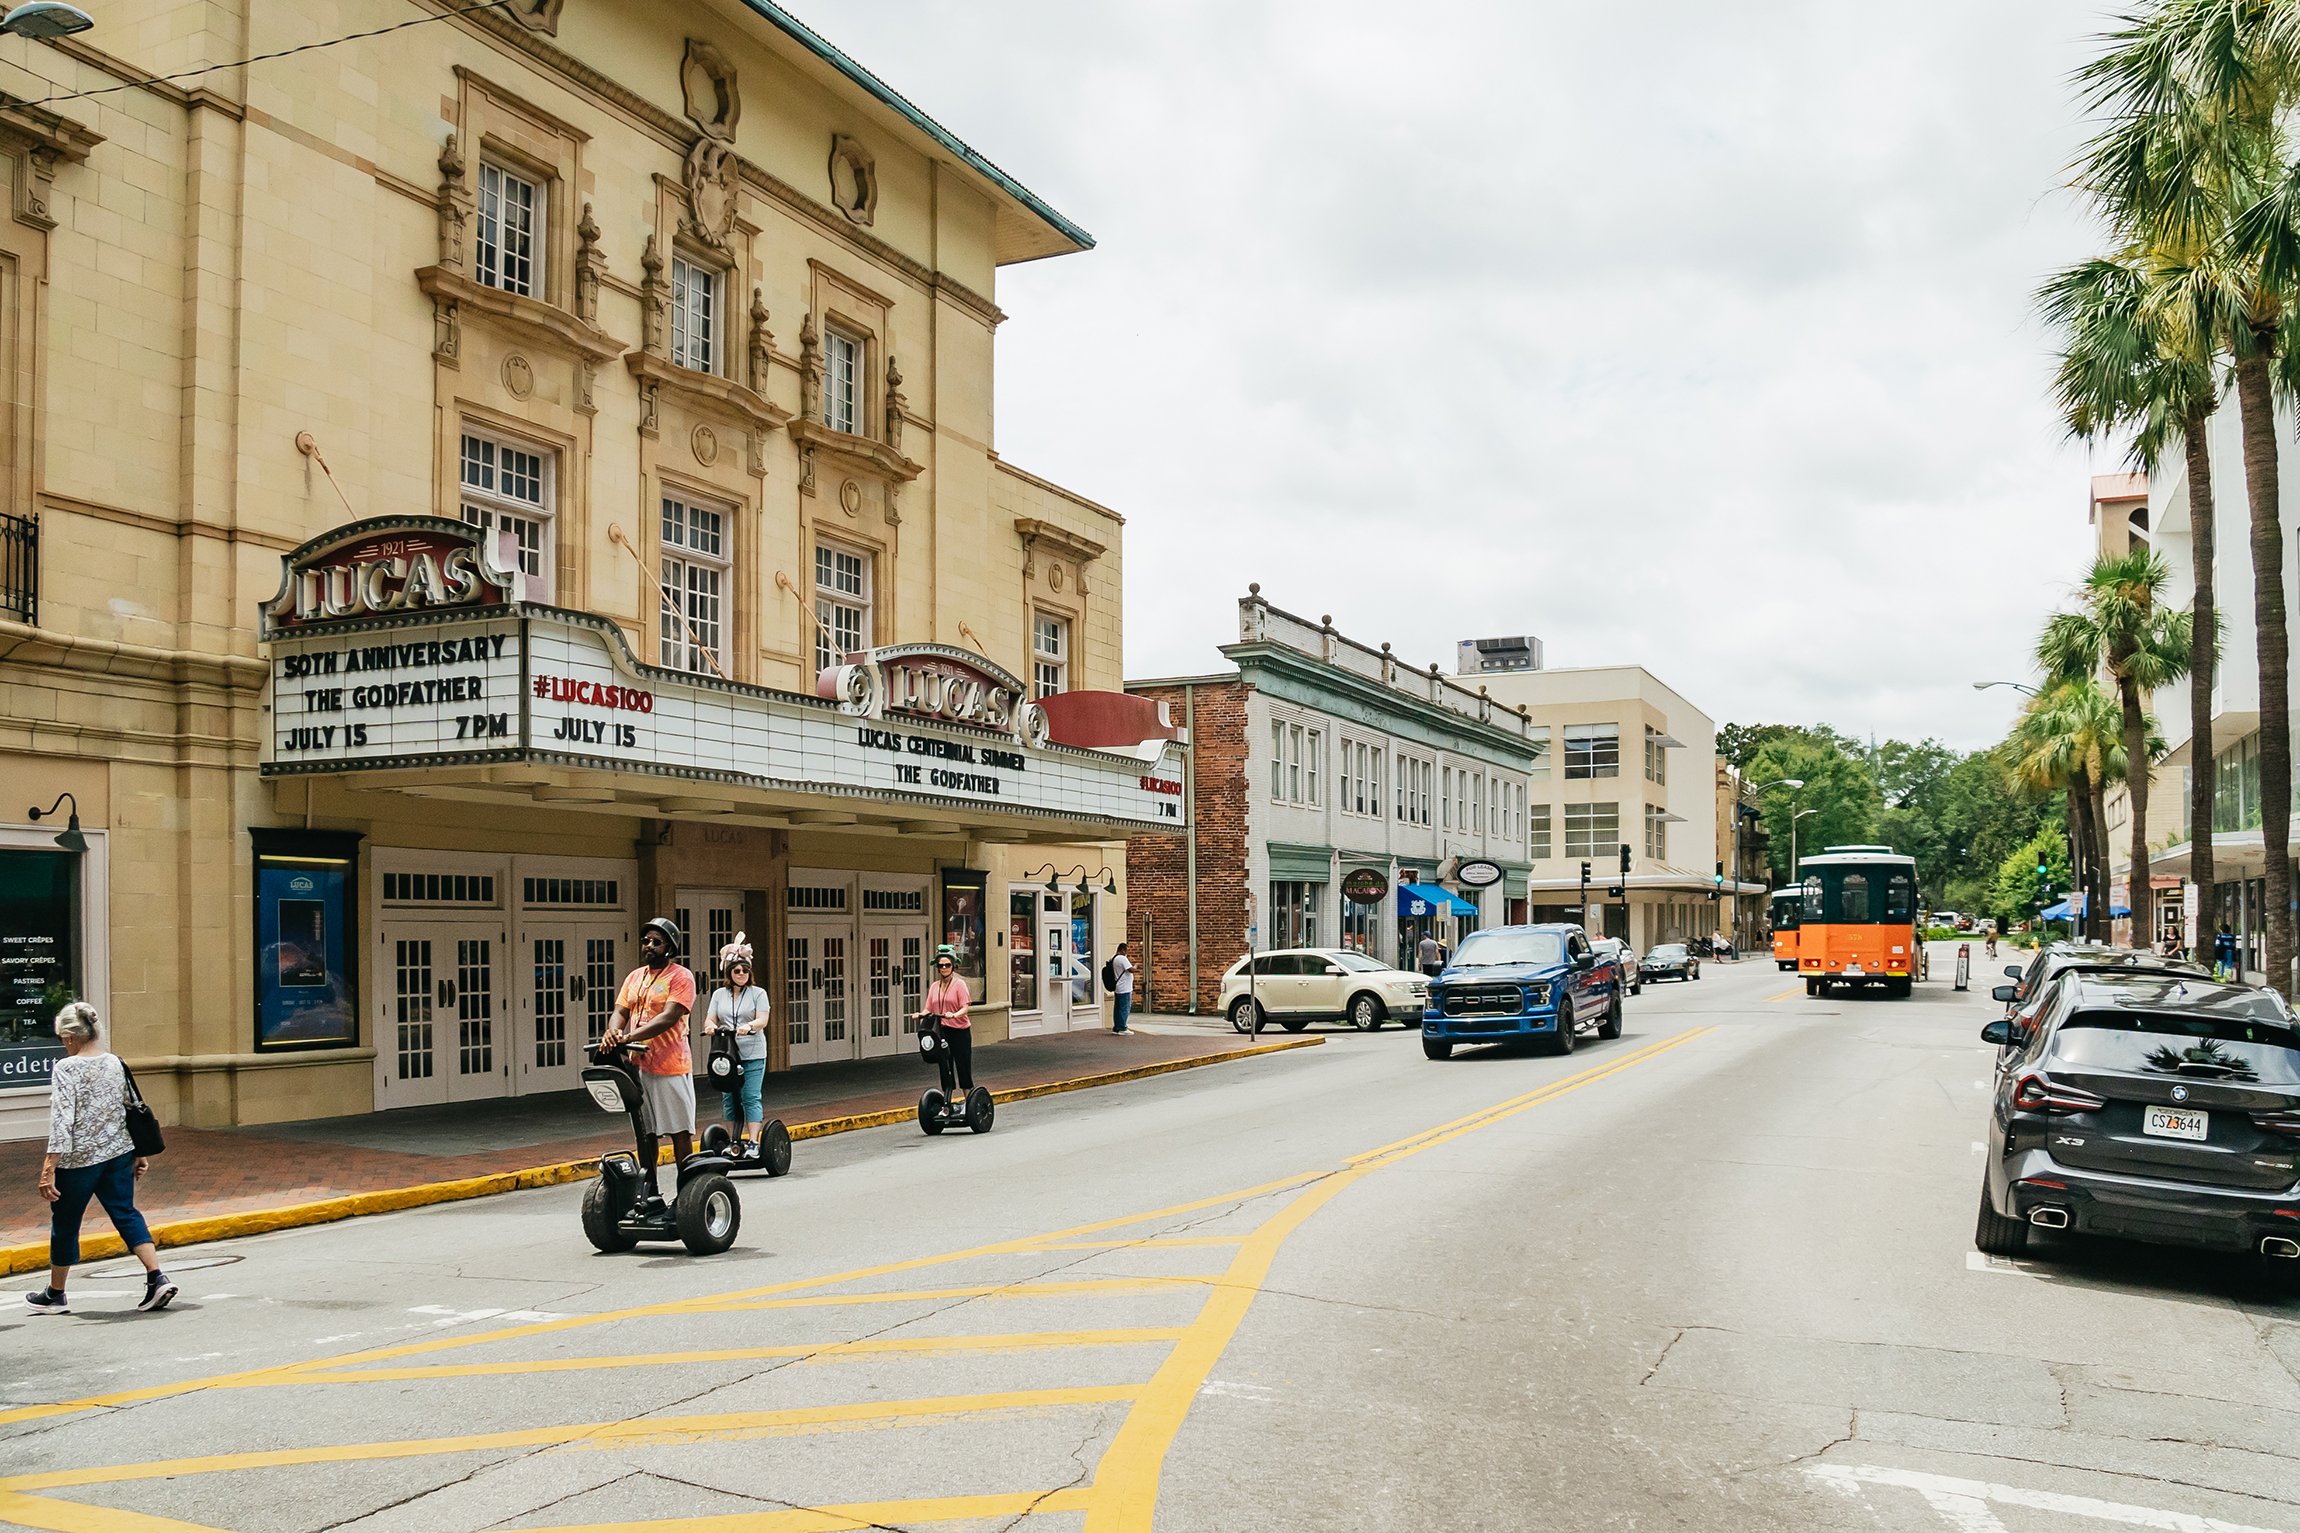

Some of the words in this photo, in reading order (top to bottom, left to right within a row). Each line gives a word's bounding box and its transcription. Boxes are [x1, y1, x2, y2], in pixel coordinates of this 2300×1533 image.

[381, 541, 404, 556] 1921
[291, 547, 484, 621] LUCAS
[284, 652, 337, 678] 50TH
[345, 634, 506, 672] ANNIVERSARY
[940, 663, 954, 675] 1921
[305, 688, 342, 712] THE
[353, 676, 482, 709] GODFATHER
[533, 674, 653, 714] #LUCAS100
[891, 665, 1009, 726] LUCAS
[285, 725, 336, 750] JULY
[345, 724, 367, 747] 15
[554, 717, 606, 744] JULY
[616, 723, 636, 747] 15
[858, 727, 901, 751] LUCAS
[907, 735, 976, 763] CENTENNIAL
[981, 748, 1025, 771] SUMMER
[896, 764, 921, 784] THE
[930, 768, 999, 794] GODFATHER
[704, 828, 744, 844] LUCAS
[290, 881, 313, 889] LUCAS
[3, 936, 26, 944] SWEET
[1, 957, 29, 965] SAVORY
[13, 977, 45, 985] PASTRIES
[16, 997, 43, 1005] COFFEE
[1447, 994, 1521, 1005] FORD
[0, 1056, 59, 1075] edett
[2152, 1113, 2201, 1132] CSZ3644
[2055, 1136, 2085, 1146] X3
